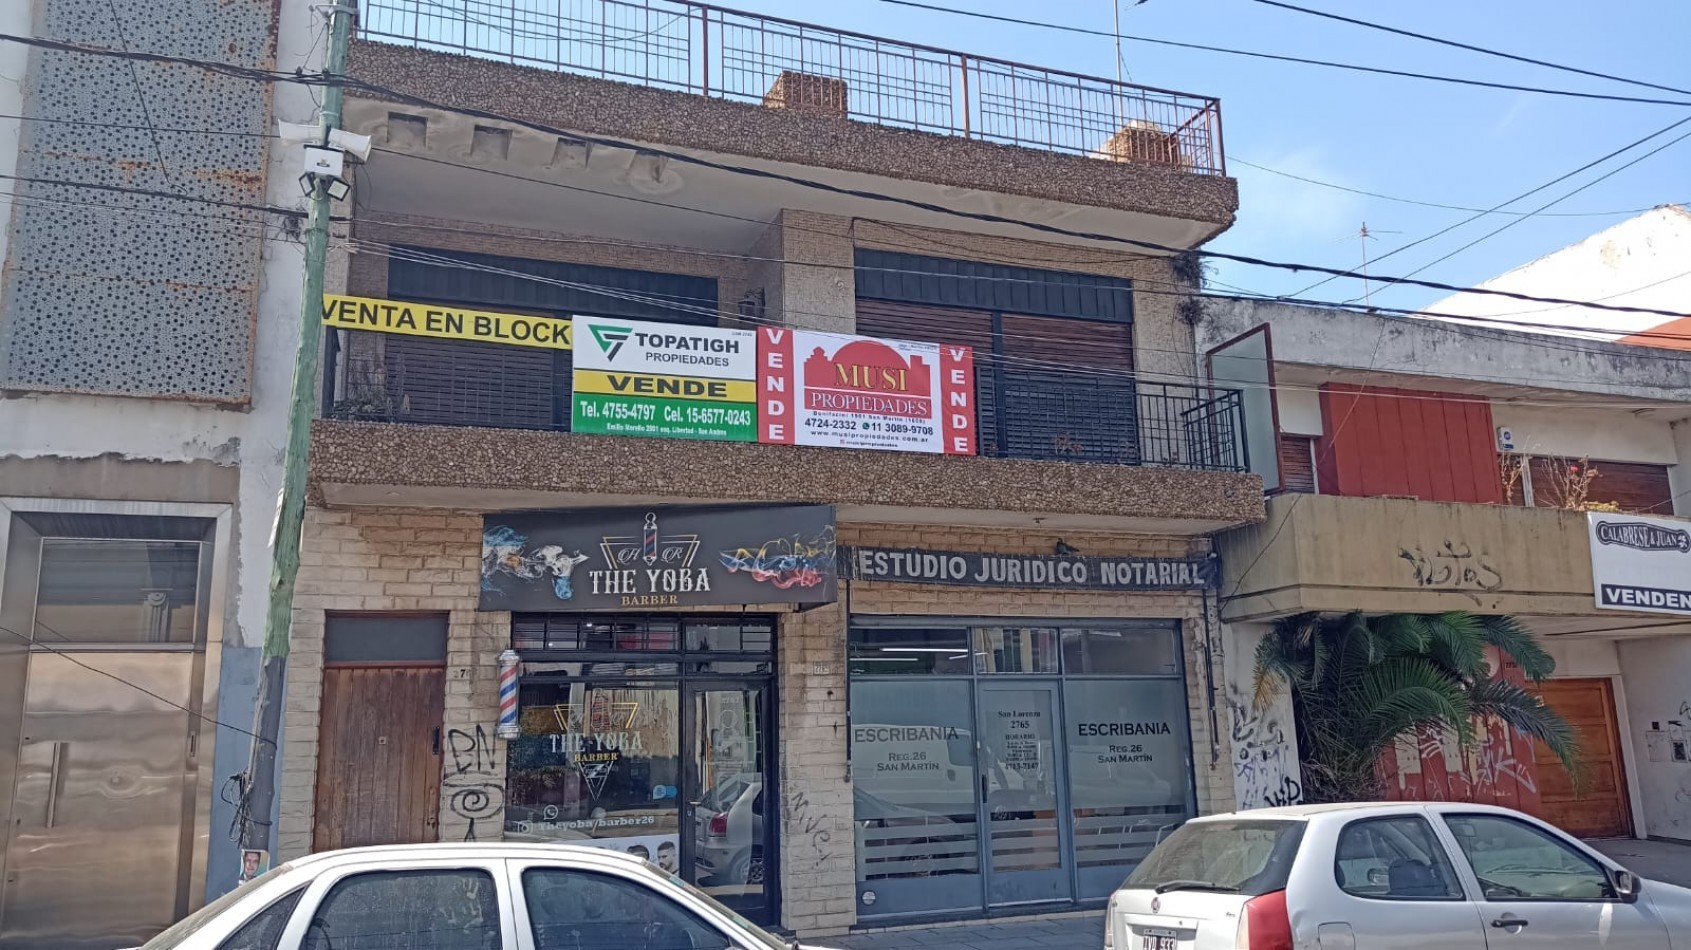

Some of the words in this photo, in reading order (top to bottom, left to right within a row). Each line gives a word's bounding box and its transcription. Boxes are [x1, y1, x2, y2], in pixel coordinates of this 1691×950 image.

[321, 299, 416, 330] VENTA
[426, 311, 463, 334] EN
[473, 316, 570, 345] BLOCK
[634, 332, 739, 354] TOPATIGH
[645, 352, 729, 367] PROPIEDADES
[607, 375, 727, 398] VENDE
[766, 328, 785, 441] VENDE
[833, 362, 909, 391] MUSI
[811, 392, 927, 415] PROPIEDADES
[949, 348, 969, 452] VENDE
[580, 401, 600, 418] Tel.
[602, 402, 656, 420] 4755-4797
[664, 406, 684, 422] Cel.
[687, 407, 751, 426] 15-6577-0243
[804, 418, 857, 430] 4724-2332
[871, 423, 882, 431] 11
[885, 424, 933, 435] 3089-9708
[1600, 526, 1651, 548] CALABRESE
[1656, 530, 1677, 546] JUAN
[860, 549, 967, 580] ESTUDIO
[974, 556, 1088, 583] JURIDICO
[1101, 561, 1205, 585] NOTARIAL
[589, 569, 637, 594] THE
[646, 567, 711, 592] YOBA
[621, 595, 678, 606] BARBER
[1605, 588, 1691, 609] VENDEN
[854, 727, 959, 743] ESCRIBANIA
[1010, 721, 1030, 729] 2765
[1078, 722, 1171, 736] ESCRIBANIA
[549, 733, 586, 753] THE
[594, 731, 642, 751] YOBA
[574, 753, 618, 762] BARBER
